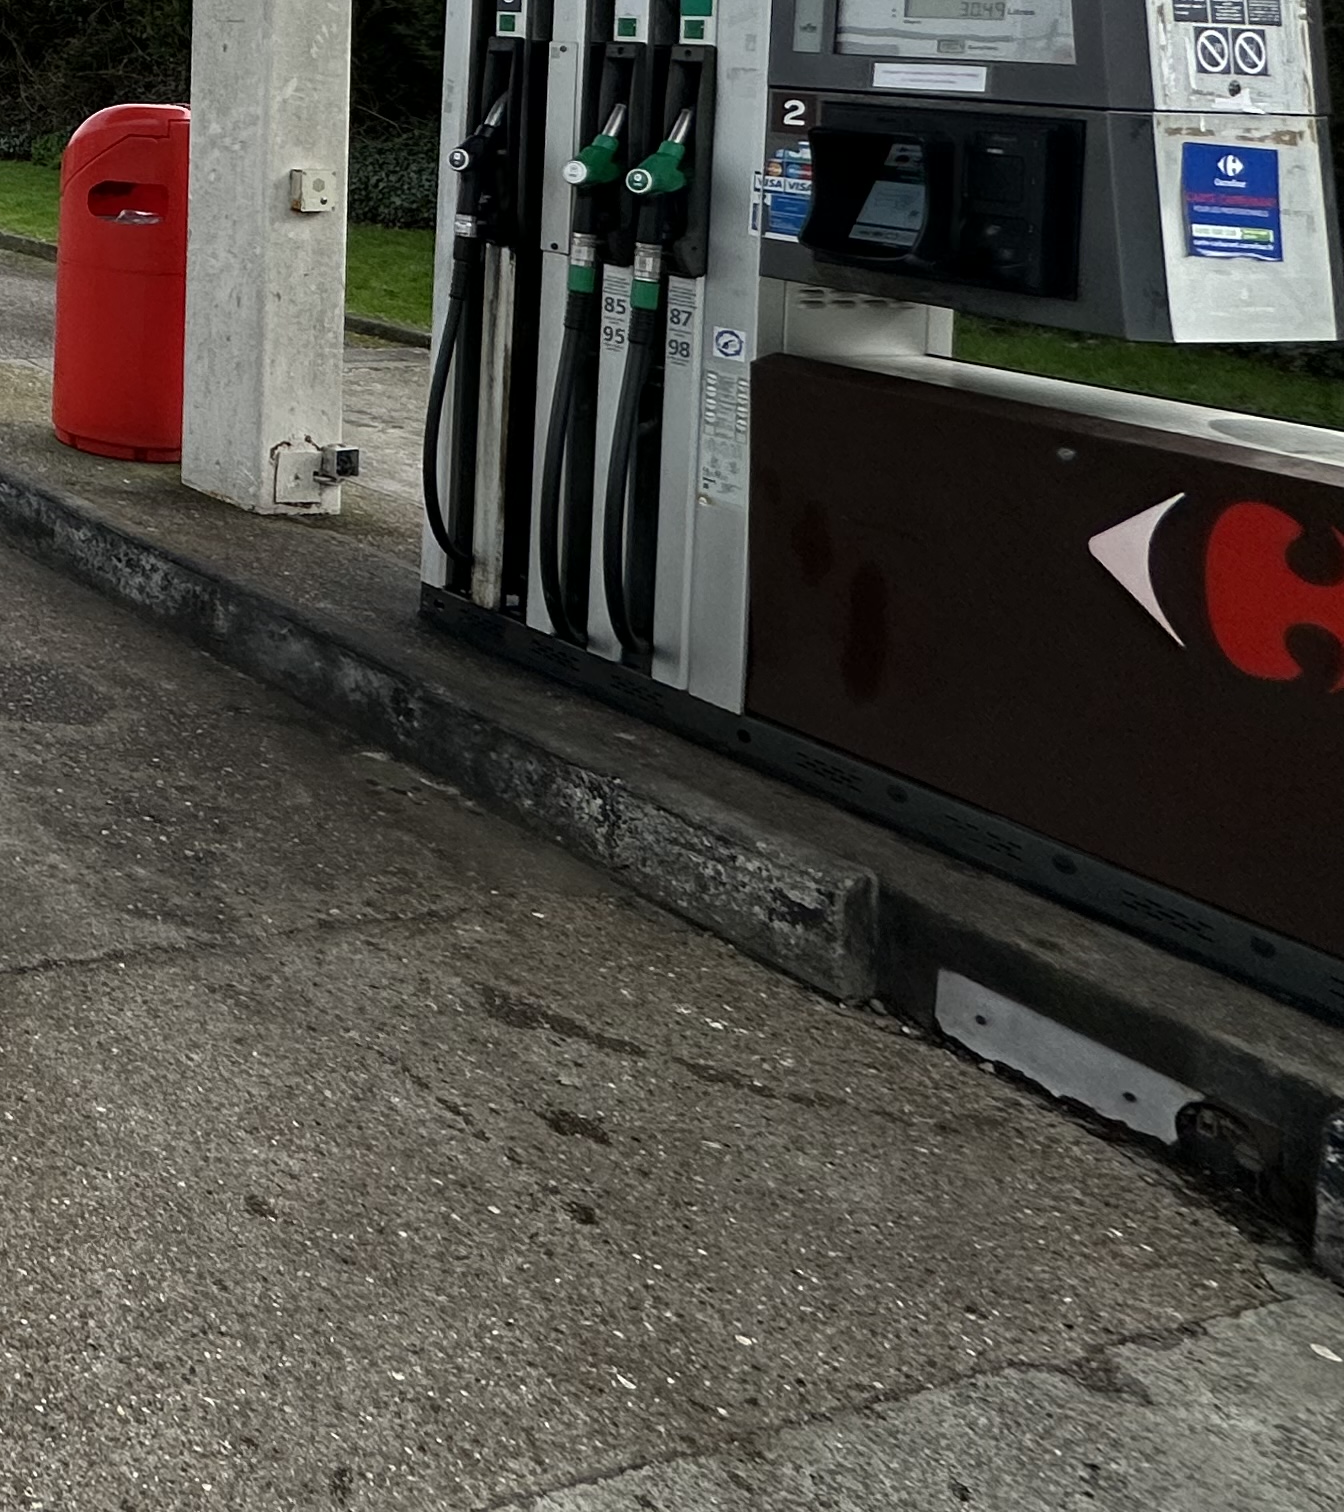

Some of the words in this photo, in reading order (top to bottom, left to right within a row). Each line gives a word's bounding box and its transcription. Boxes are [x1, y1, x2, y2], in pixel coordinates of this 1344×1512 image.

[783, 99, 806, 126] 2
[604, 296, 626, 315] 85
[669, 308, 692, 326] 87
[602, 325, 625, 344] 95
[668, 339, 690, 358] 98
